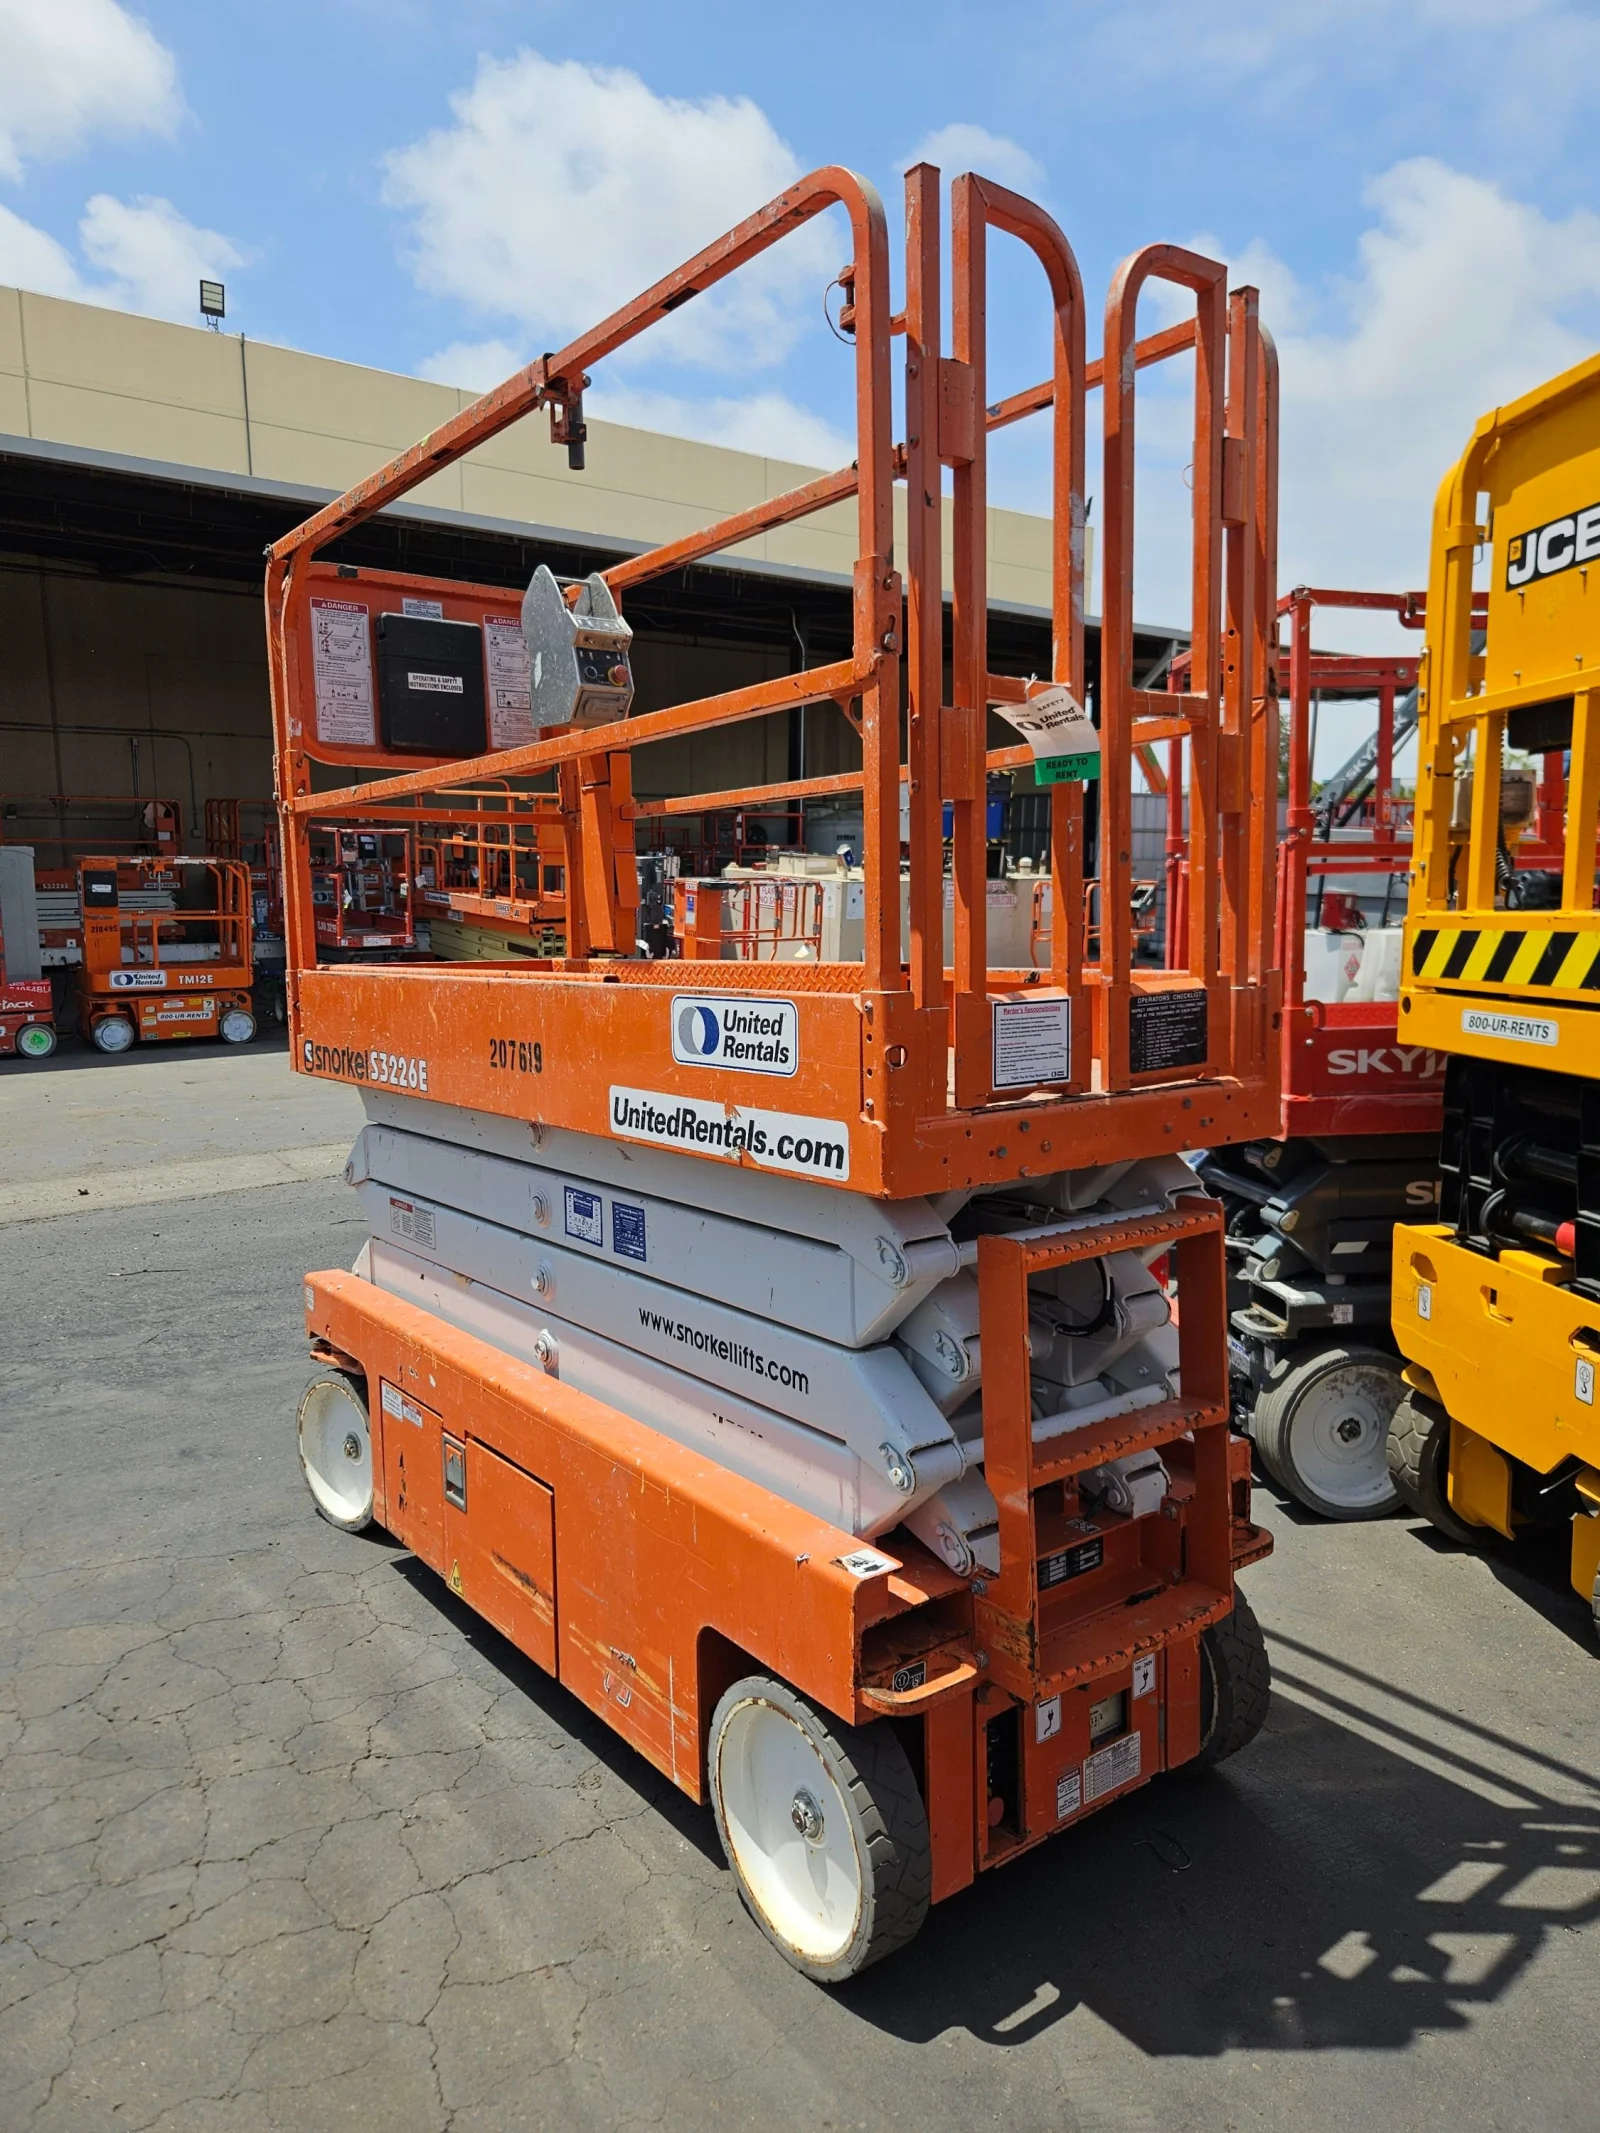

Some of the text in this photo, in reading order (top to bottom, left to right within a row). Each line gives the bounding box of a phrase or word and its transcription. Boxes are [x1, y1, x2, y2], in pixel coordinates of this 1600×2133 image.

[327, 602, 359, 612] DANGER
[410, 681, 462, 691] INSTRUCTIONS ENCLOSED
[1037, 698, 1064, 711] SAFETY
[1039, 707, 1075, 724] United
[1046, 713, 1085, 730] Rentals
[1046, 758, 1088, 769] READY TO
[1055, 770, 1078, 779] RENT
[179, 975, 214, 984] TM12E
[1173, 991, 1202, 1000] CHECKLIST
[160, 1012, 210, 1020] 800-UR-RENTS
[723, 1009, 784, 1036] United
[1468, 1015, 1550, 1039] 800-UR-RENTS
[723, 1035, 790, 1064] Rentals
[315, 1045, 429, 1092] snorkel S3226E
[613, 1096, 845, 1170] UnitedRentals.com
[638, 1307, 809, 1394] www.snorkellifts.com
